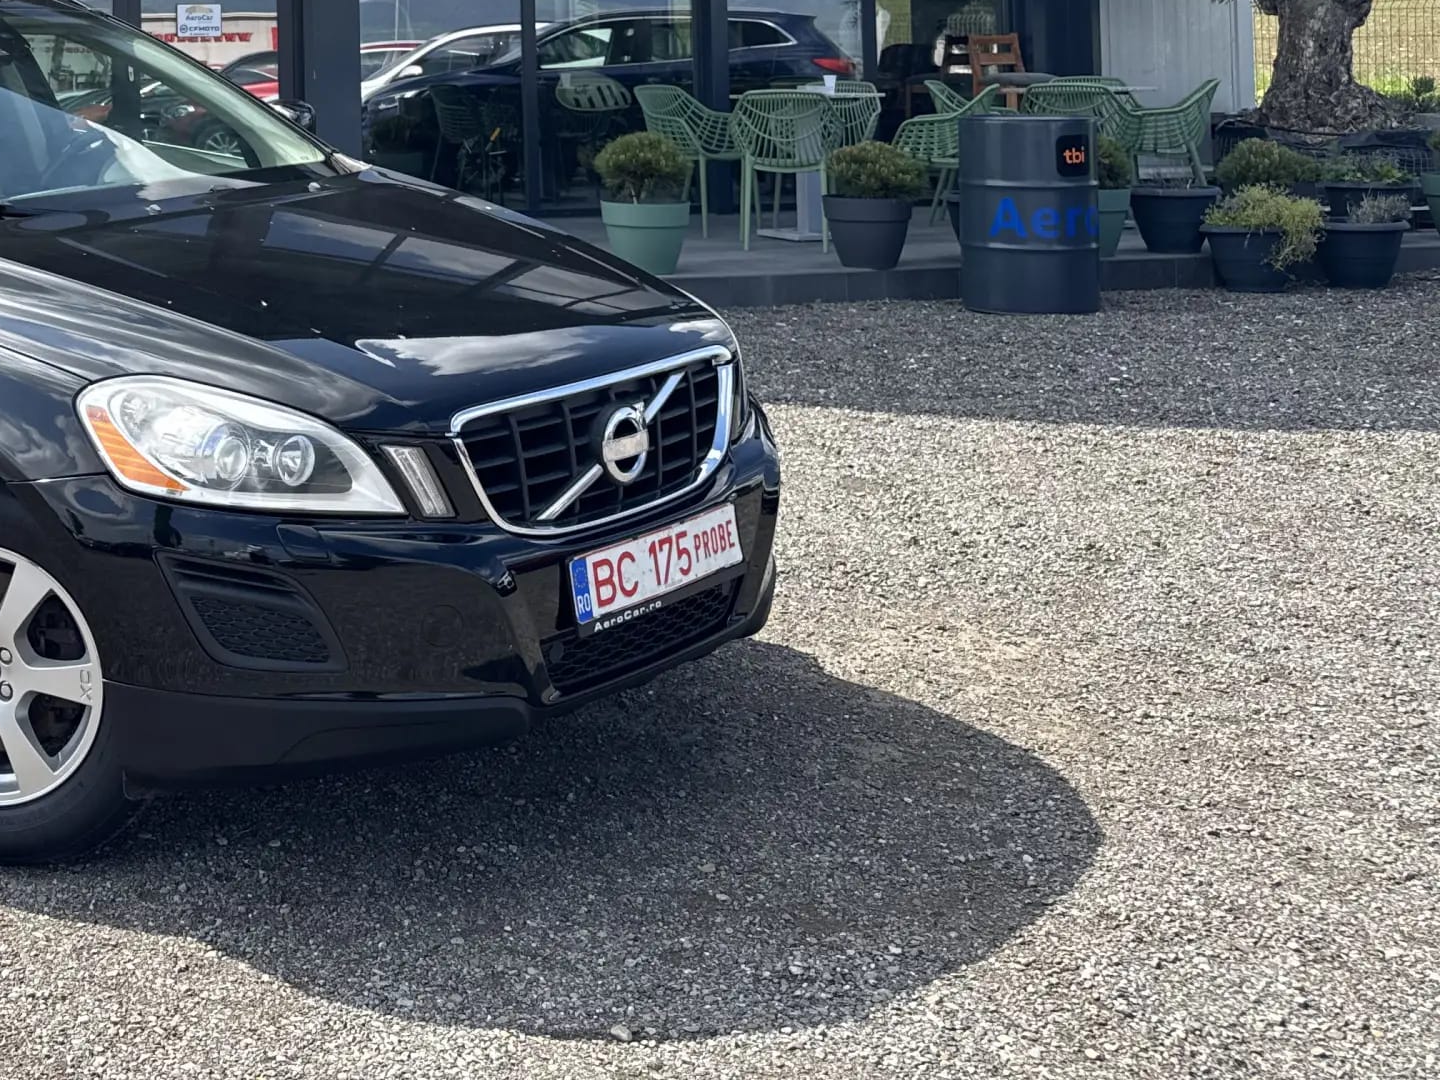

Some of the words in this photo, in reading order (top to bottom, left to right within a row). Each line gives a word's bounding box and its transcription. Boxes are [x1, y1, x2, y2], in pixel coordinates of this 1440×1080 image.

[185, 14, 214, 22] AeroCar
[188, 25, 220, 33] CFMOTO
[1063, 146, 1085, 164] tbi
[591, 550, 640, 609] BC
[648, 530, 693, 587] 175
[693, 520, 735, 562] PROBE
[577, 593, 592, 615] RO
[593, 600, 663, 633] AeroCar.ro
